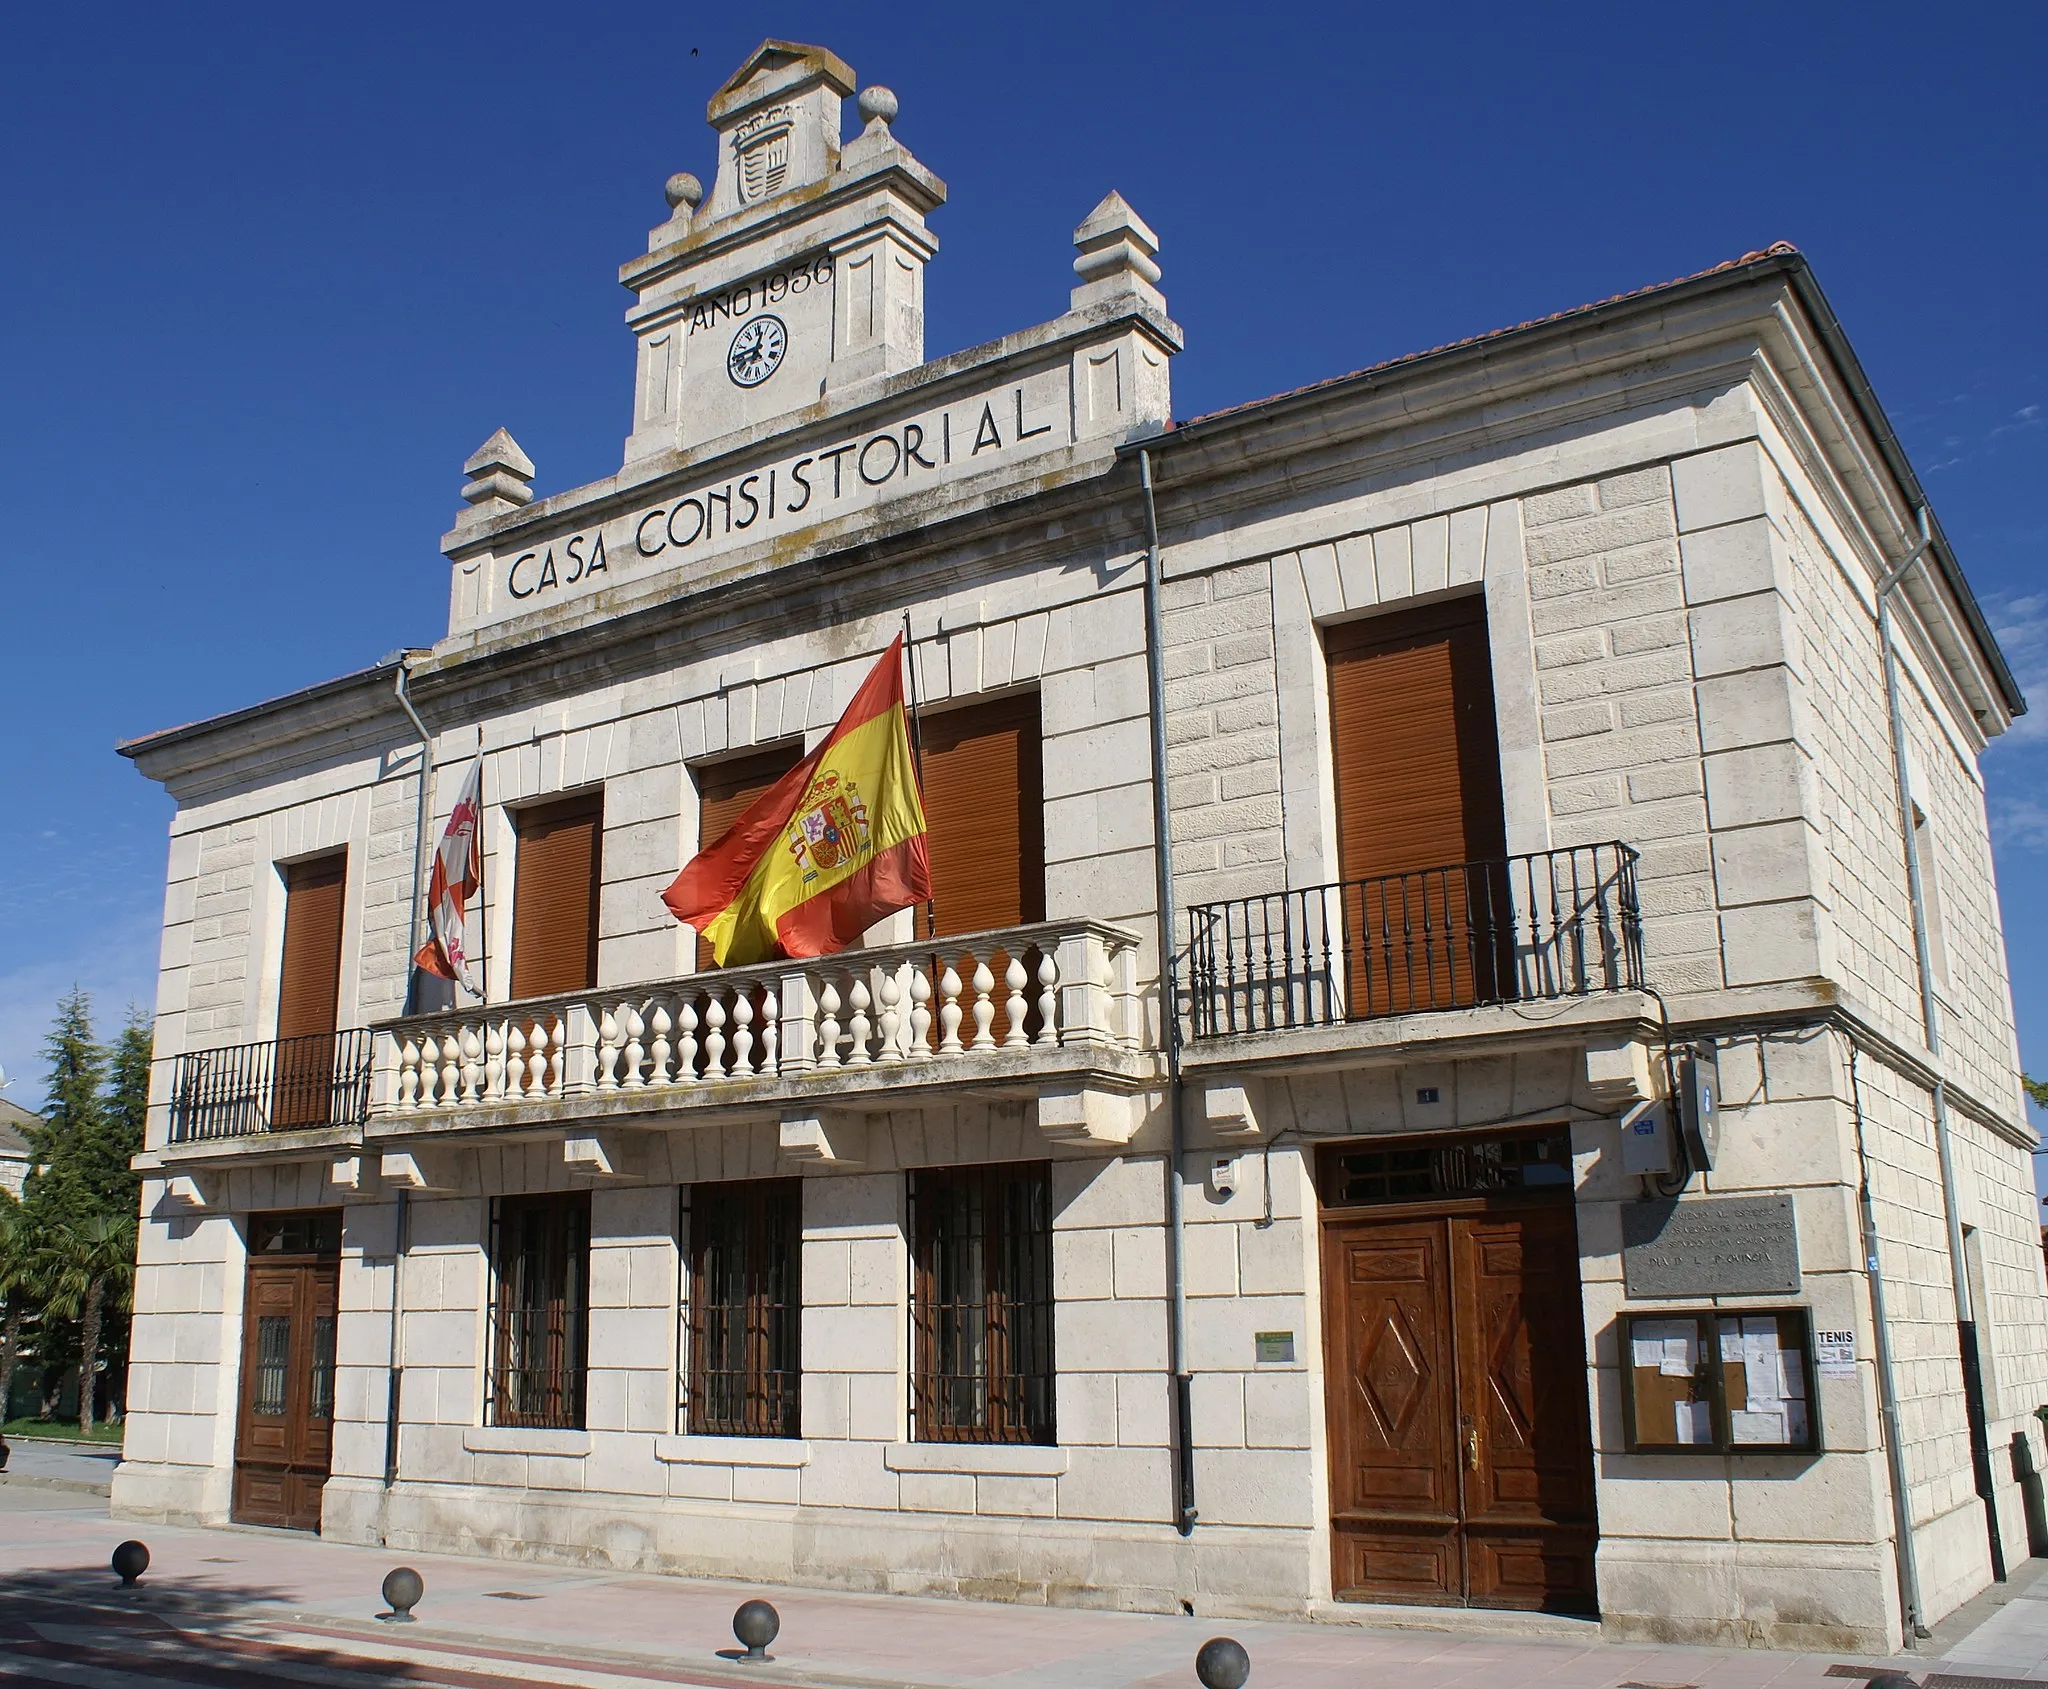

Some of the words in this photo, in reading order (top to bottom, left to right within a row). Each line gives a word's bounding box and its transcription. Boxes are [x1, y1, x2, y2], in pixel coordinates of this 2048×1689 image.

[760, 255, 834, 308] 1936
[508, 530, 608, 600] CASA
[635, 388, 1052, 558] CONSISTORIAL
[1818, 1331, 1853, 1343] TENIS
